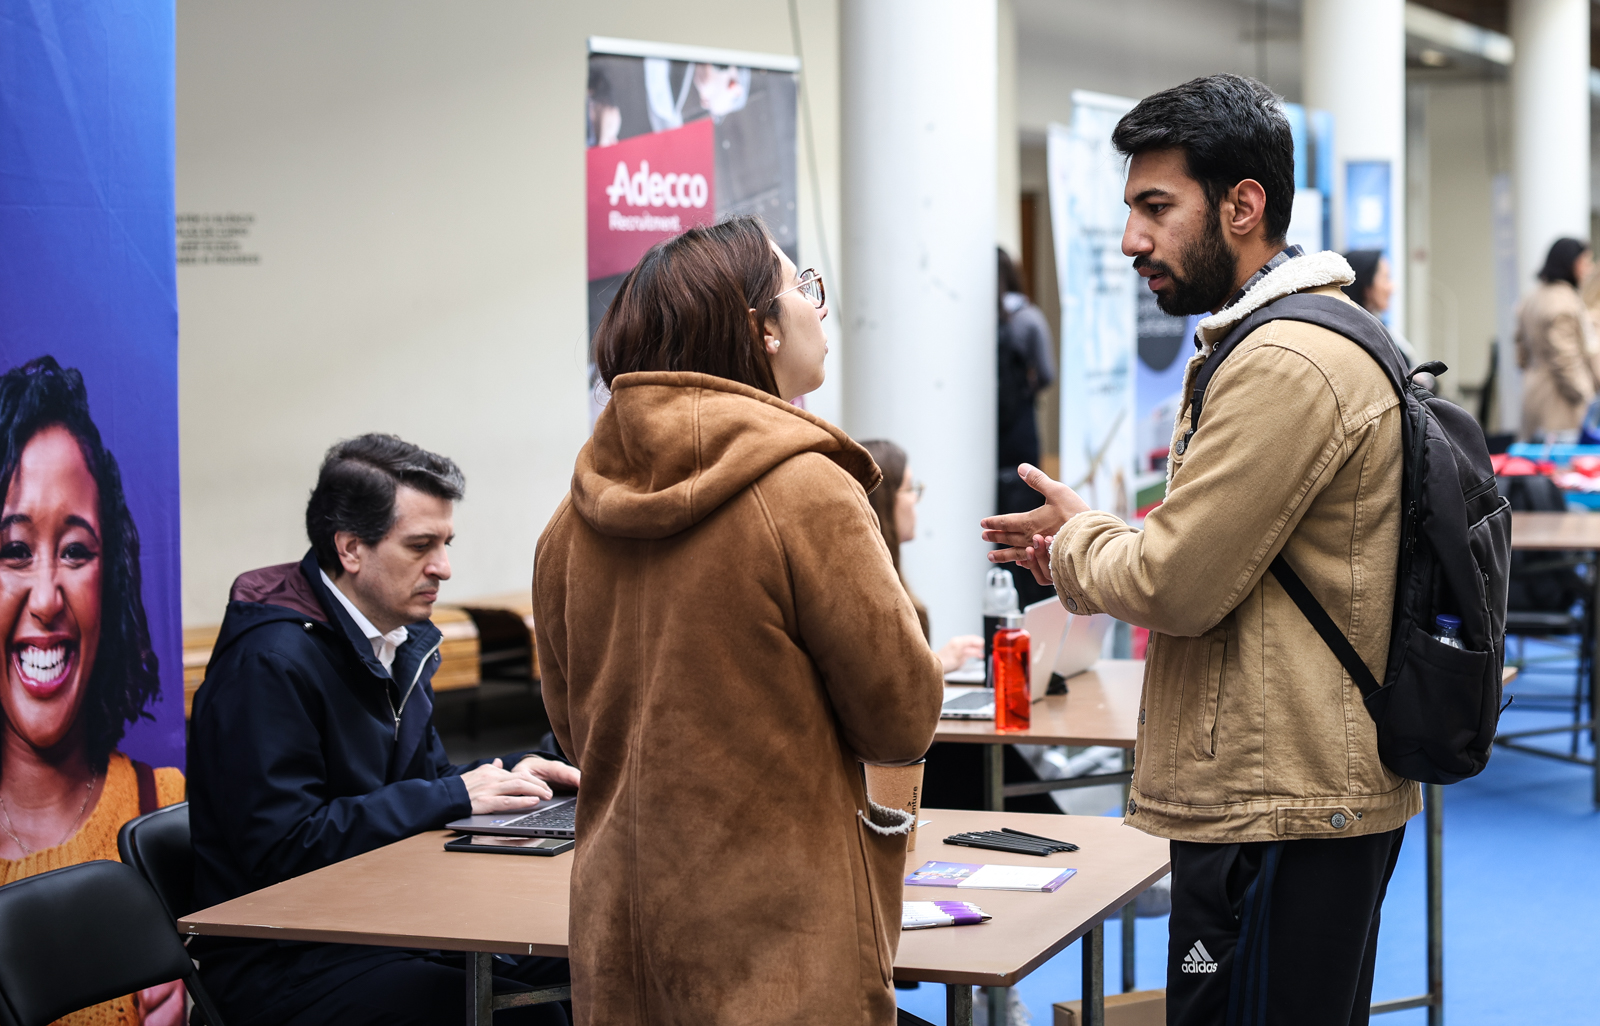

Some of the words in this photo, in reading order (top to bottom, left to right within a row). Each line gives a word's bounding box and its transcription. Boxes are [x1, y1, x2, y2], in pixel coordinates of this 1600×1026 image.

[606, 160, 708, 208] Adecco
[609, 210, 680, 232] Recruitment
[1181, 961, 1218, 973] adidas
